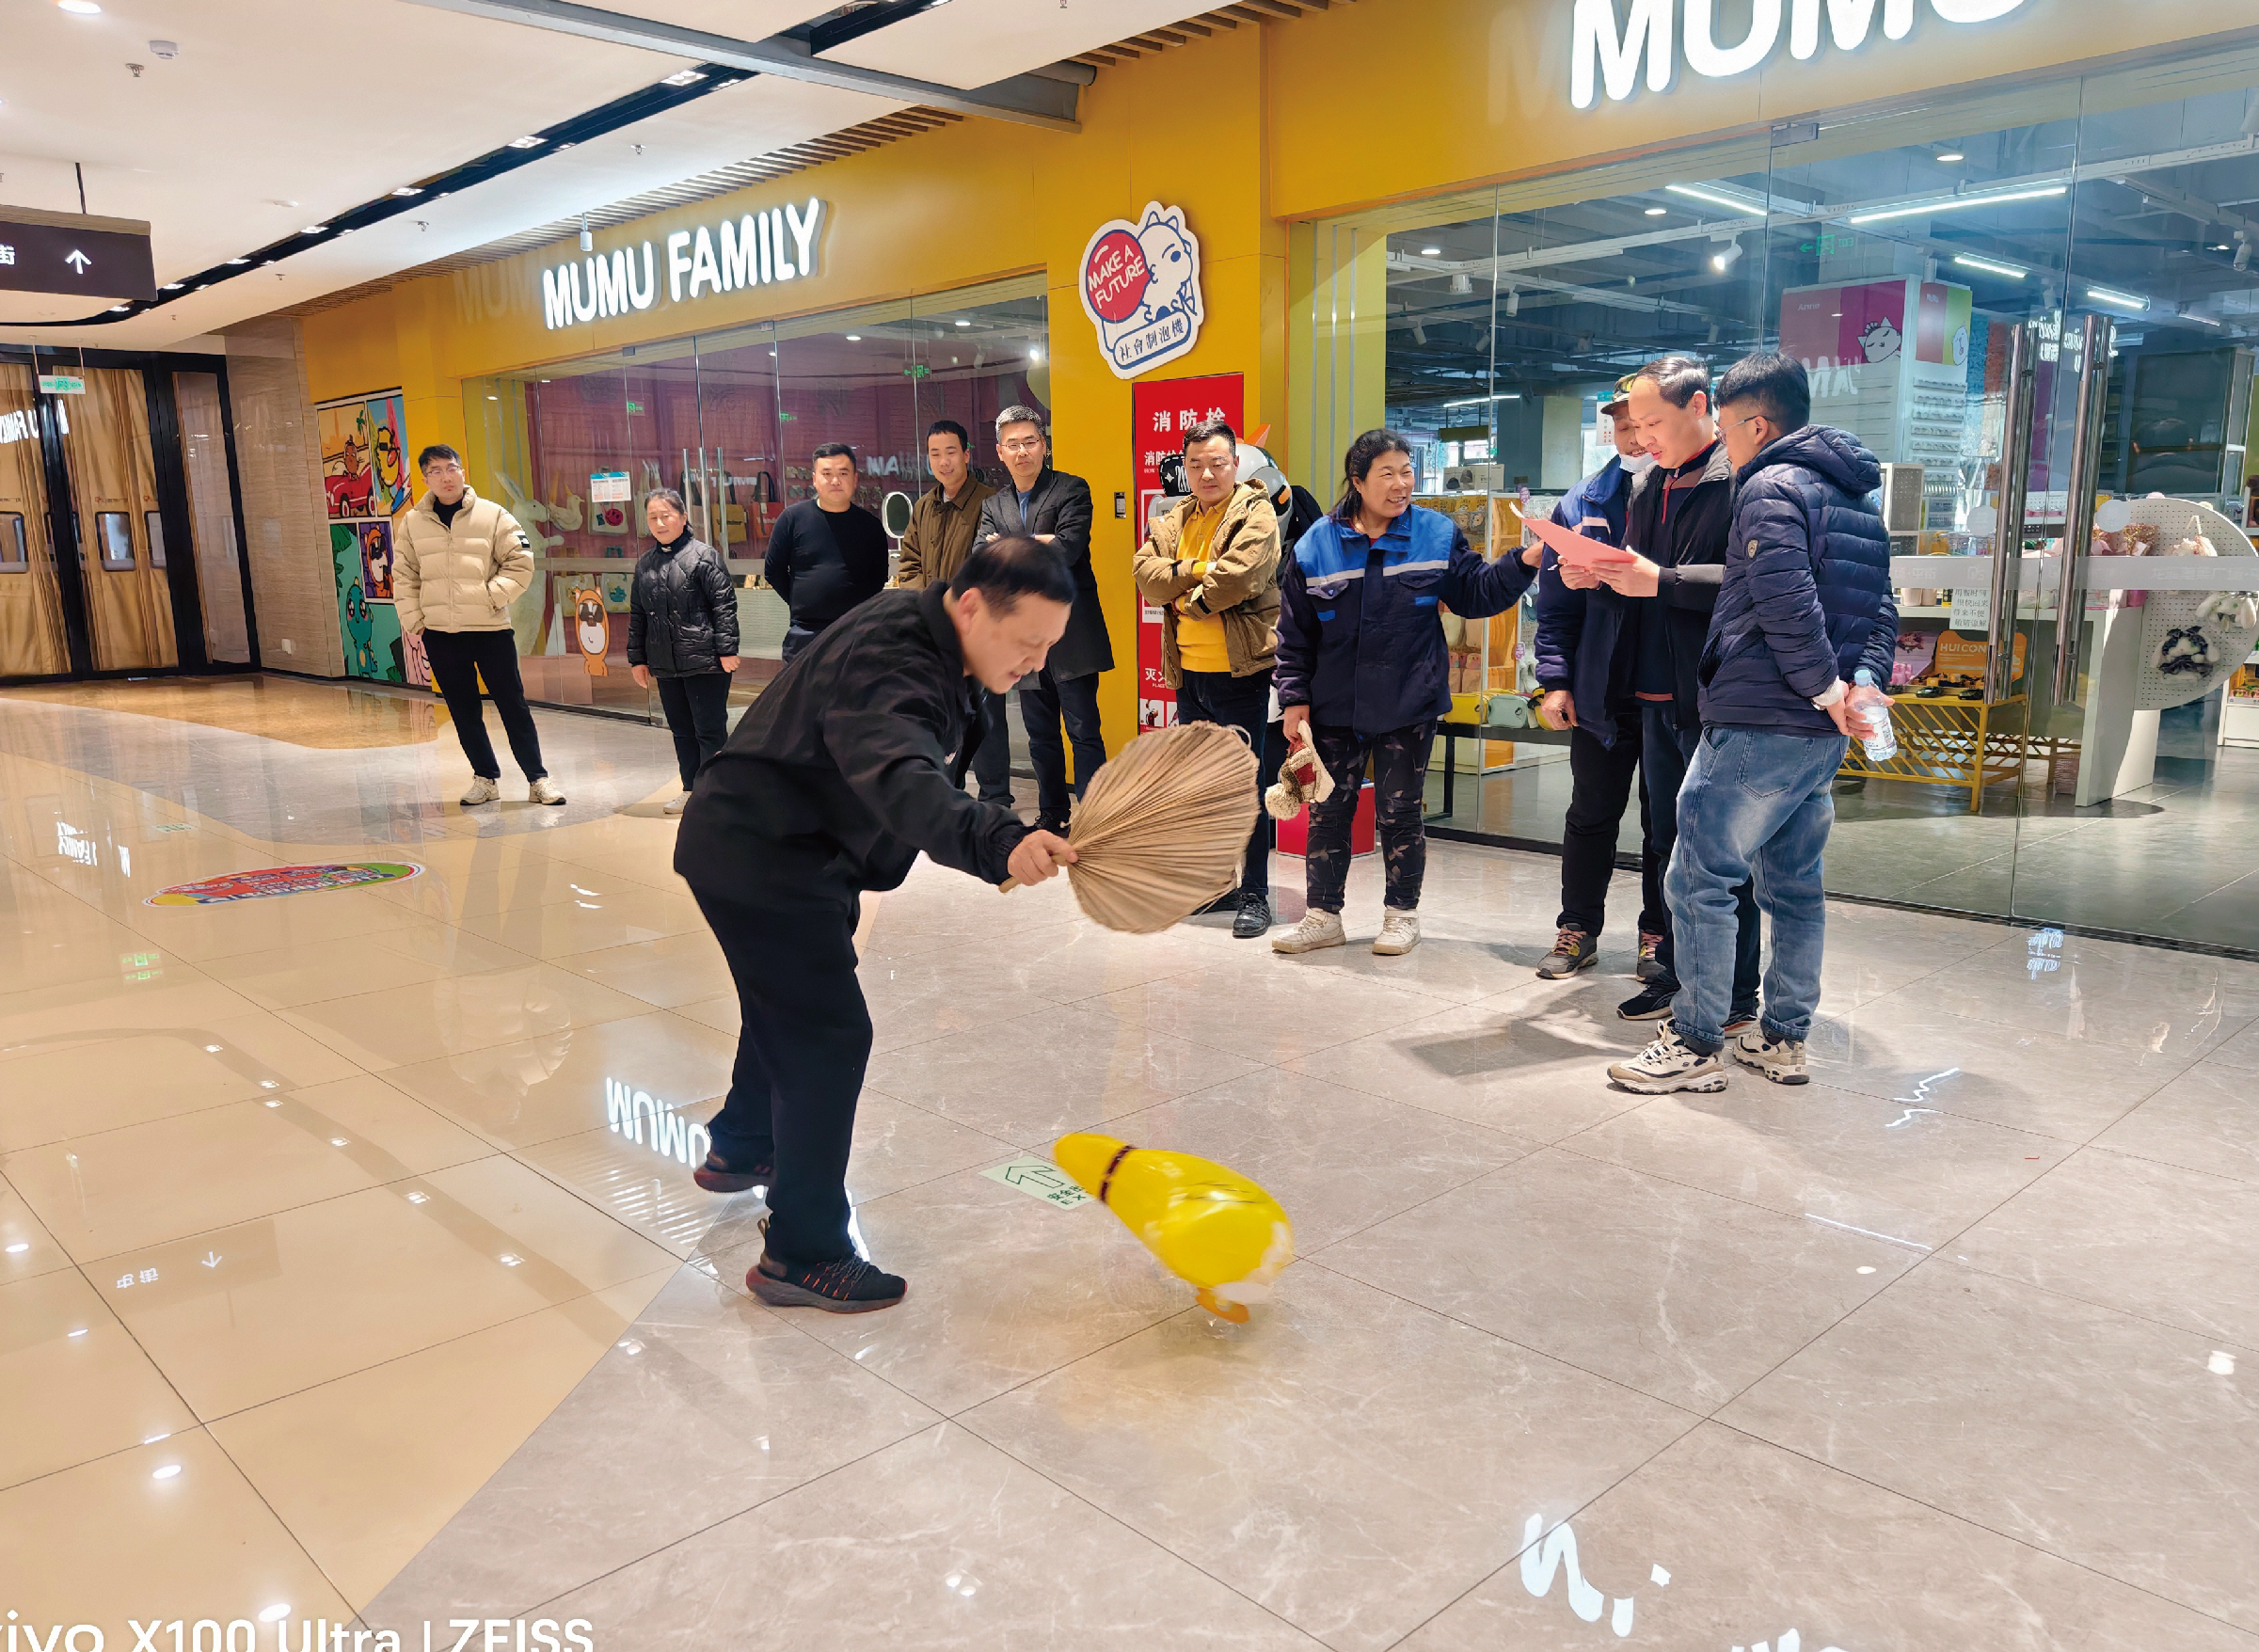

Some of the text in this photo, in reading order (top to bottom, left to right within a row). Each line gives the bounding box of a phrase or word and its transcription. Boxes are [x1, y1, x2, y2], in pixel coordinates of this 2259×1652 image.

[1571, 0, 2030, 109] MU
[543, 241, 655, 330] MUMU
[667, 196, 820, 303] FAMILY
[1088, 244, 1135, 293] MAKE A
[1094, 255, 1146, 310] FUTURE
[1153, 407, 1226, 433] 消防栓
[1144, 450, 1185, 466] 消防
